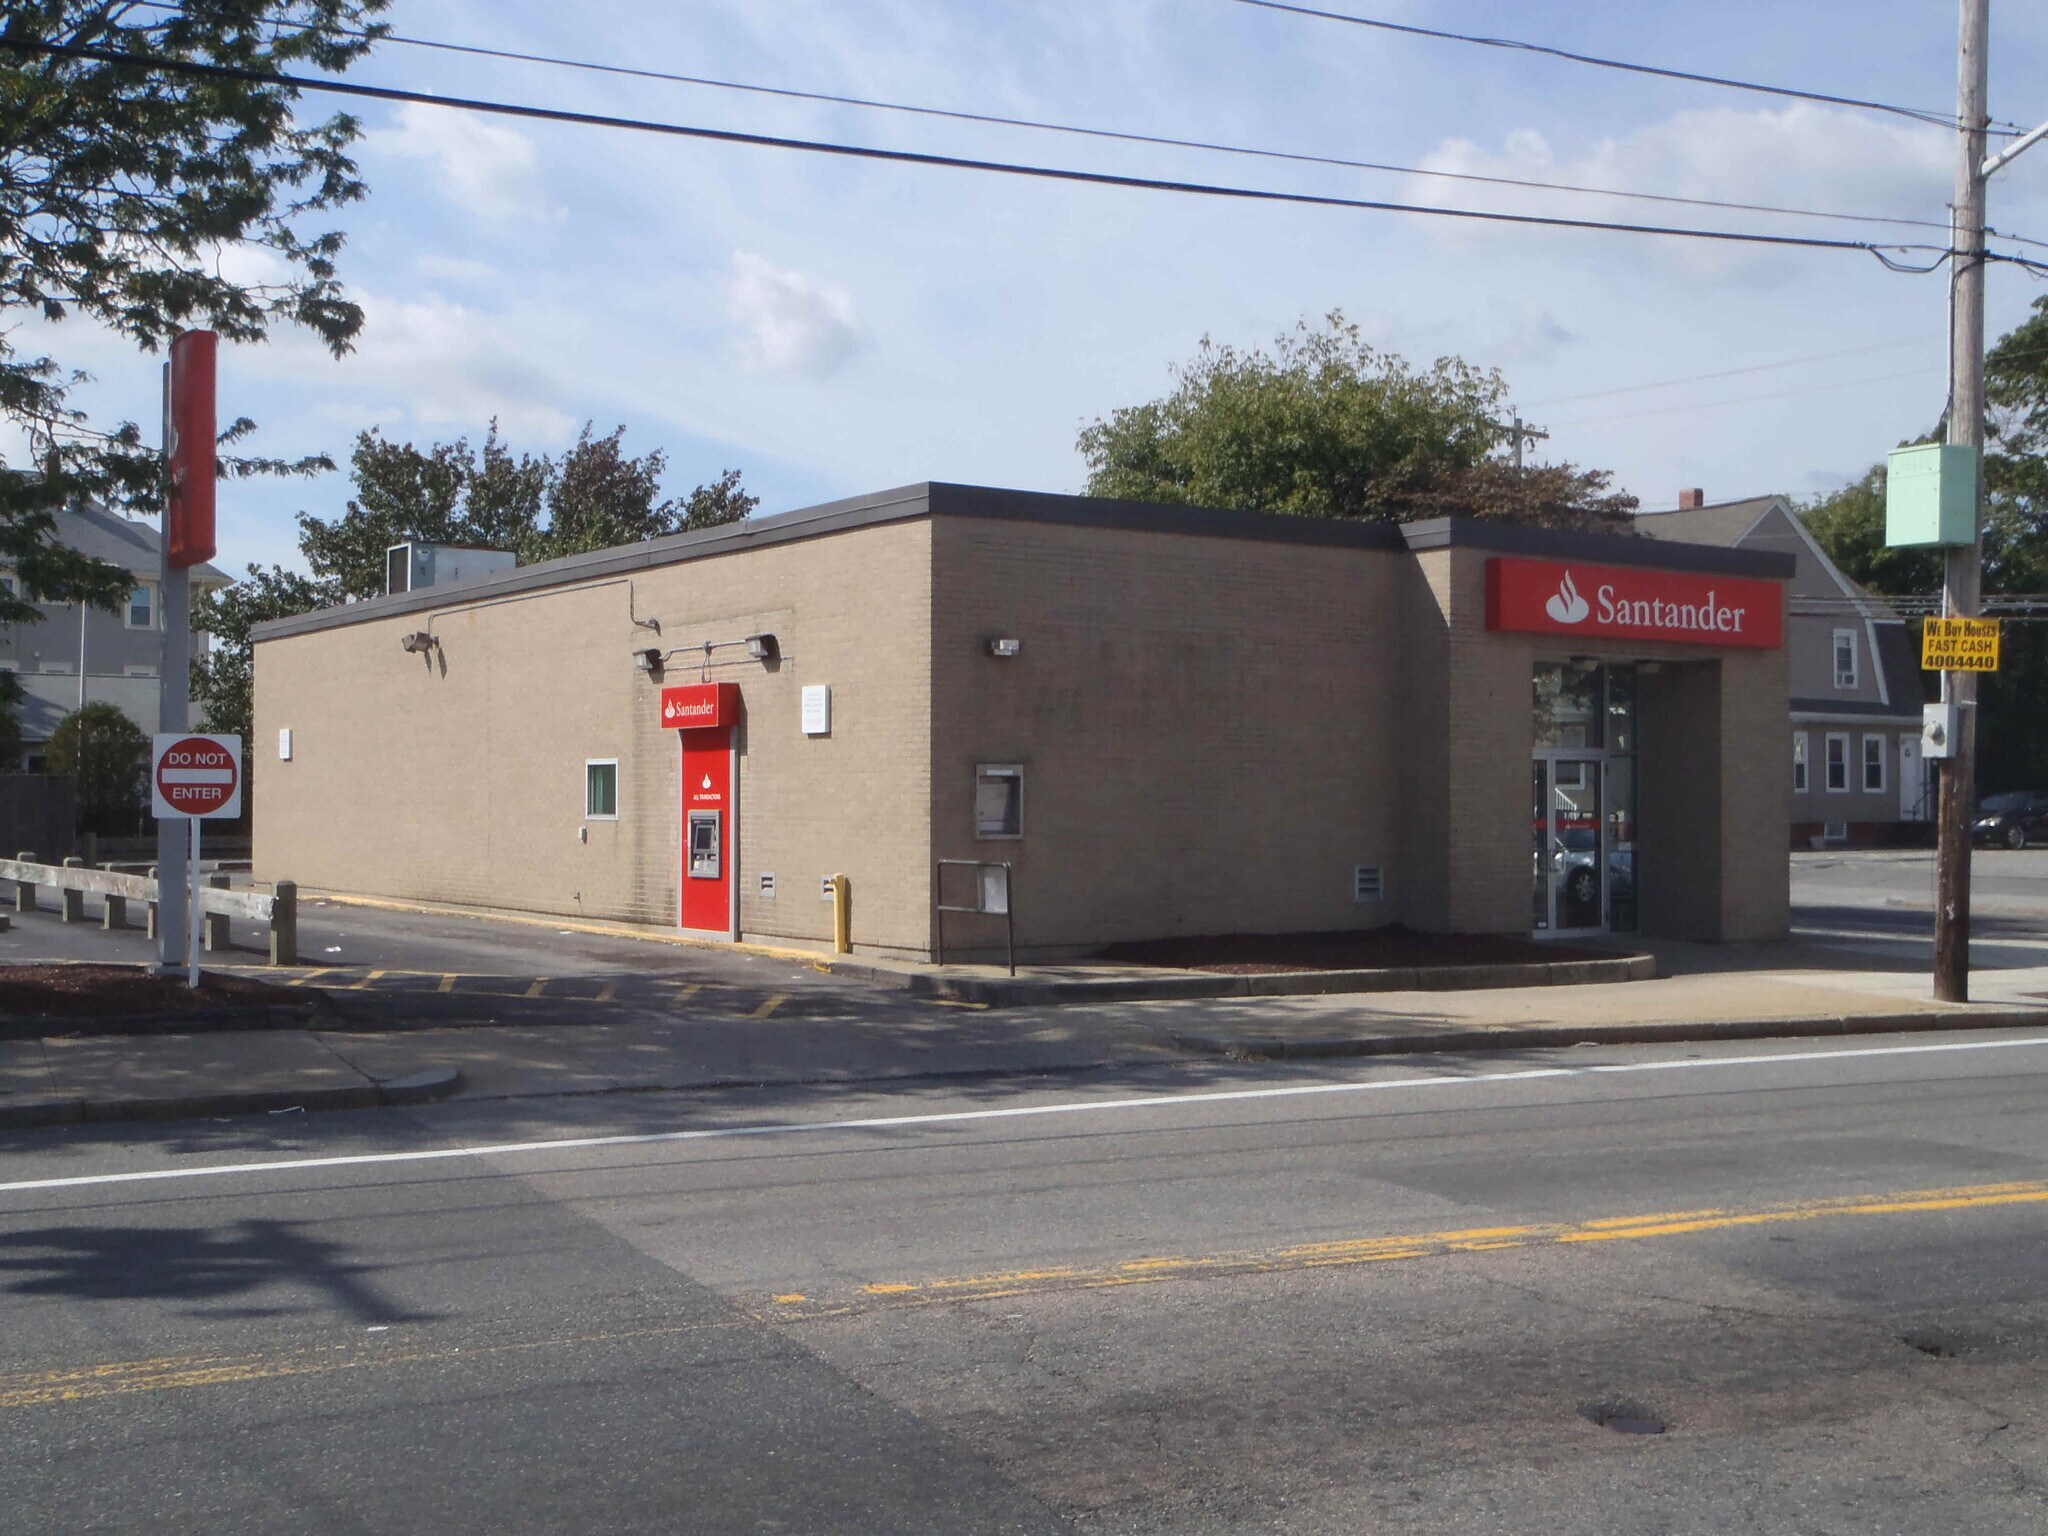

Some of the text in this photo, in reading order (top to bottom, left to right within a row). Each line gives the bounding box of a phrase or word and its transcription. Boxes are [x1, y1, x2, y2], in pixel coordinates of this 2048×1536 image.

[1597, 585, 1746, 633] Santander
[1928, 639, 1992, 652] FAST CASH
[1925, 655, 1994, 668] 4004440
[676, 697, 714, 717] Santander
[169, 752, 227, 764] DO NOT
[172, 787, 222, 799] ENTER
